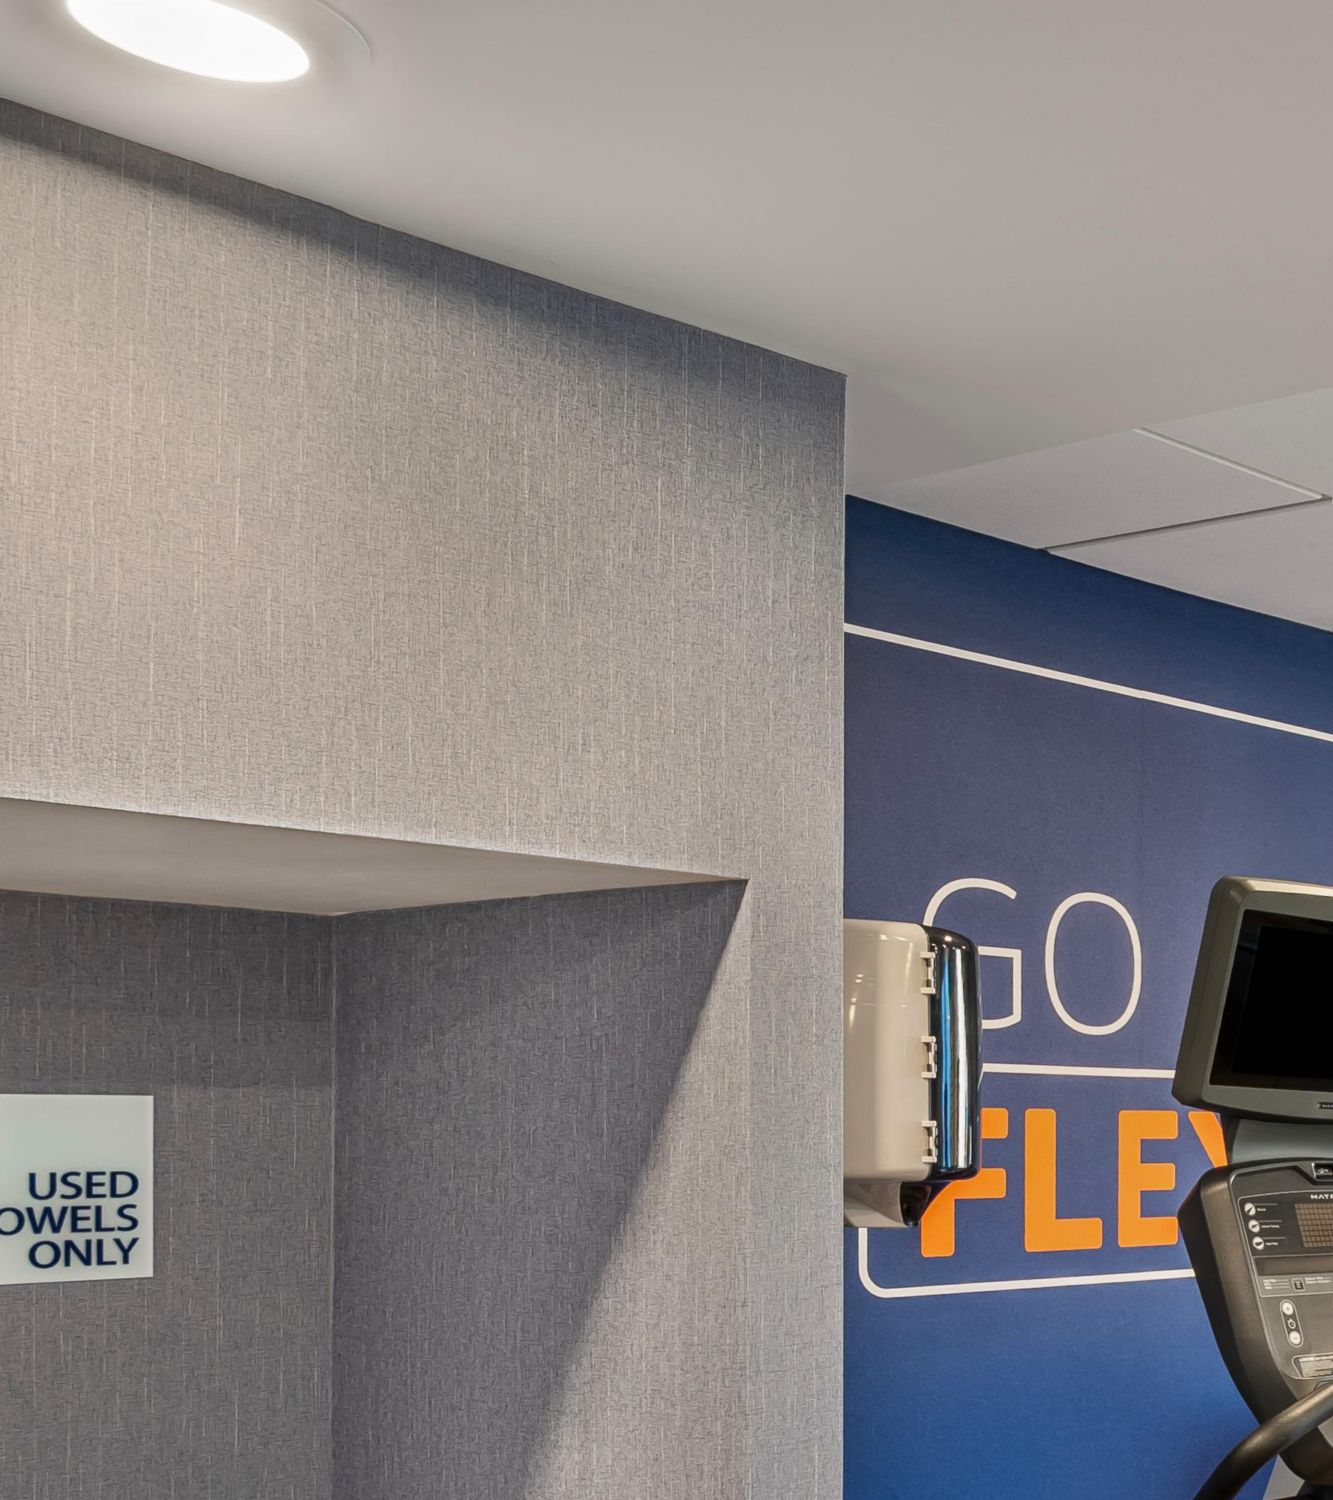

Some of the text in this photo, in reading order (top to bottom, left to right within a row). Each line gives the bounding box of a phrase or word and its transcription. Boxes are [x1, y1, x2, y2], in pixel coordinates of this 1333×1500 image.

[923, 877, 1142, 1036] GO
[28, 1171, 139, 1200] USED
[920, 1107, 1228, 1257] FLE
[28, 1237, 140, 1269] ONLY
